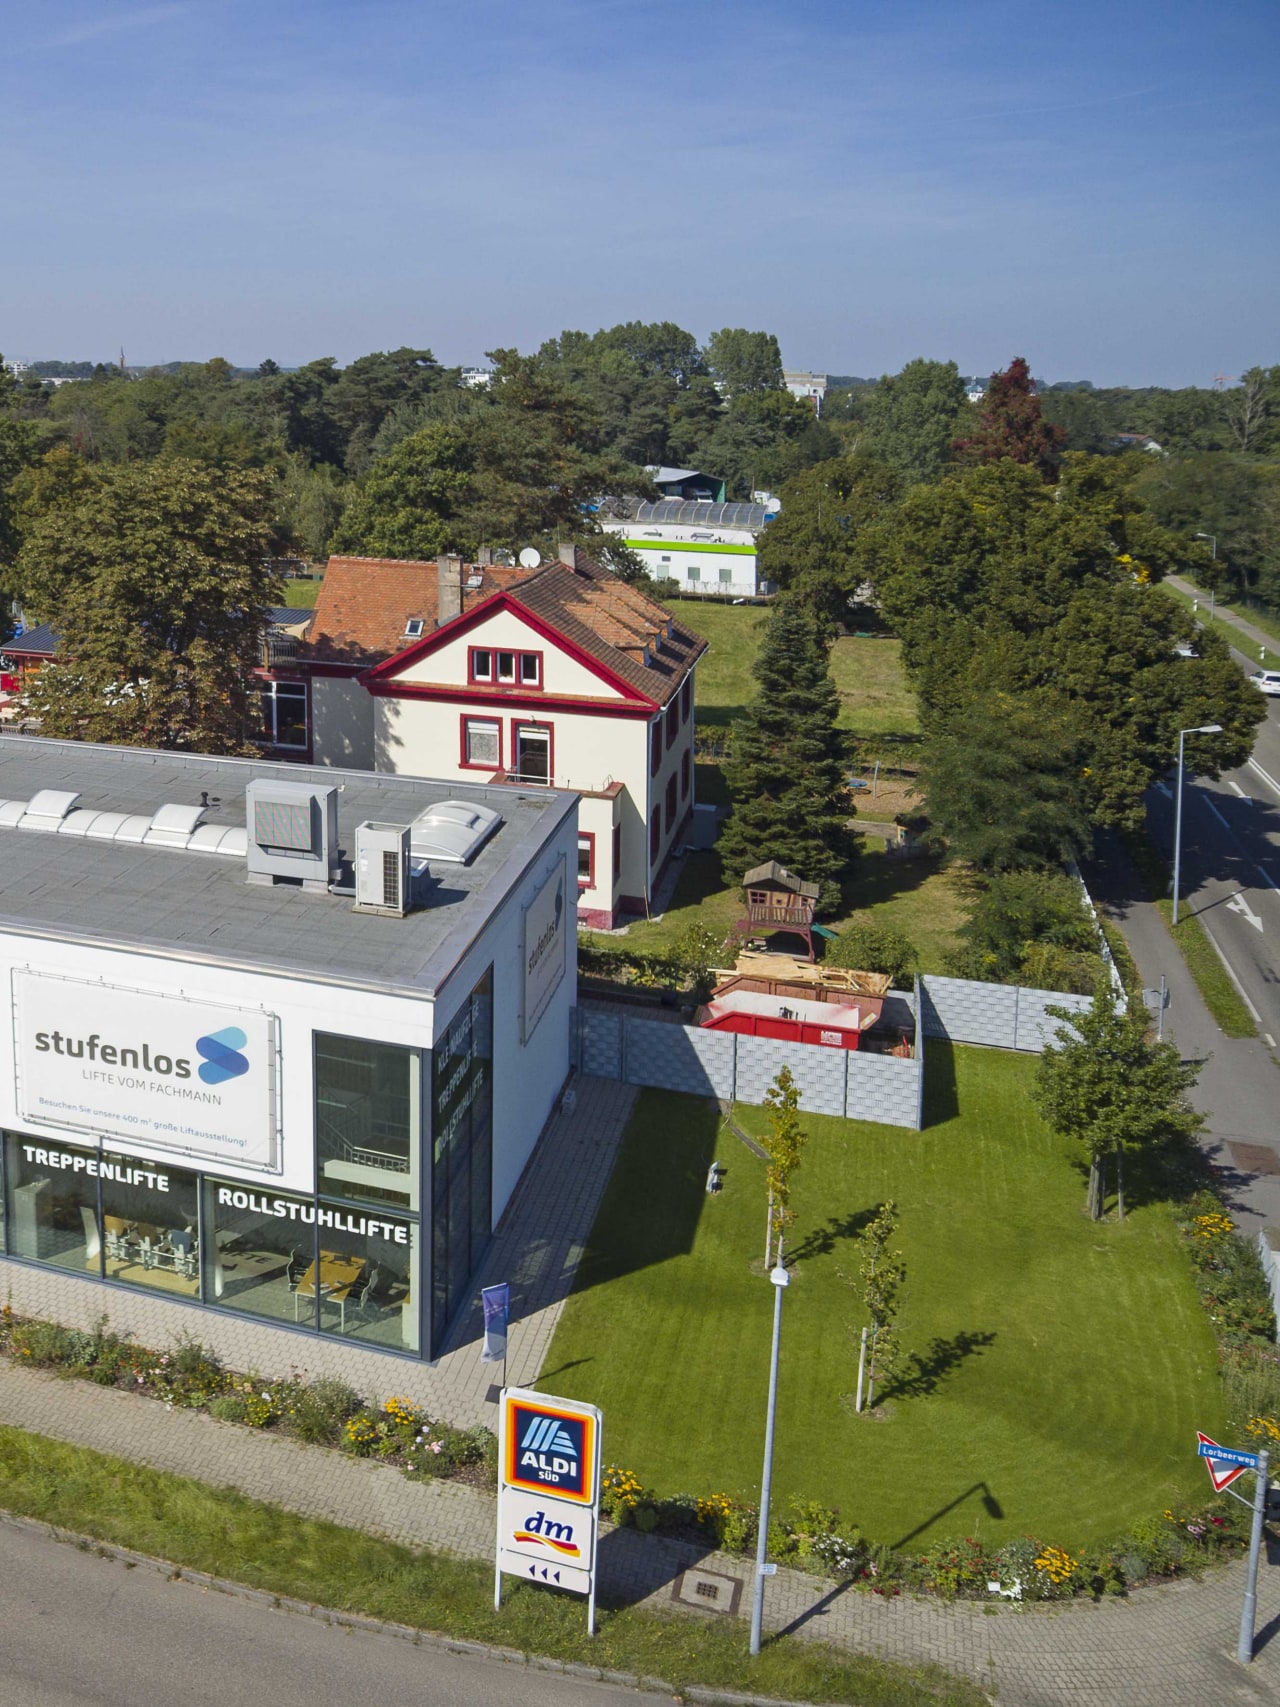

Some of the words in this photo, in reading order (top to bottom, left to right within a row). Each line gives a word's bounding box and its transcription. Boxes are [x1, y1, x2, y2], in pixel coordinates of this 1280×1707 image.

[35, 1031, 191, 1079] stufenlos
[82, 1069, 114, 1085] LIFTE
[117, 1076, 146, 1091] VOM
[150, 1082, 222, 1106] FACHMANN
[38, 1097, 78, 1111] Besuchen
[79, 1105, 91, 1113] Sie
[93, 1109, 120, 1119] unsere
[122, 1115, 138, 1124] 400
[154, 1122, 178, 1132] große
[180, 1126, 247, 1147] Liftausstellung!
[23, 1145, 170, 1192] TREPPENLIFTE
[218, 1188, 407, 1244] ROLLSTUHLLIFTE
[521, 1451, 577, 1477] ALDI
[1203, 1446, 1256, 1466] Lorbeerweg
[538, 1470, 560, 1483] SÜD
[524, 1511, 574, 1541] dm
